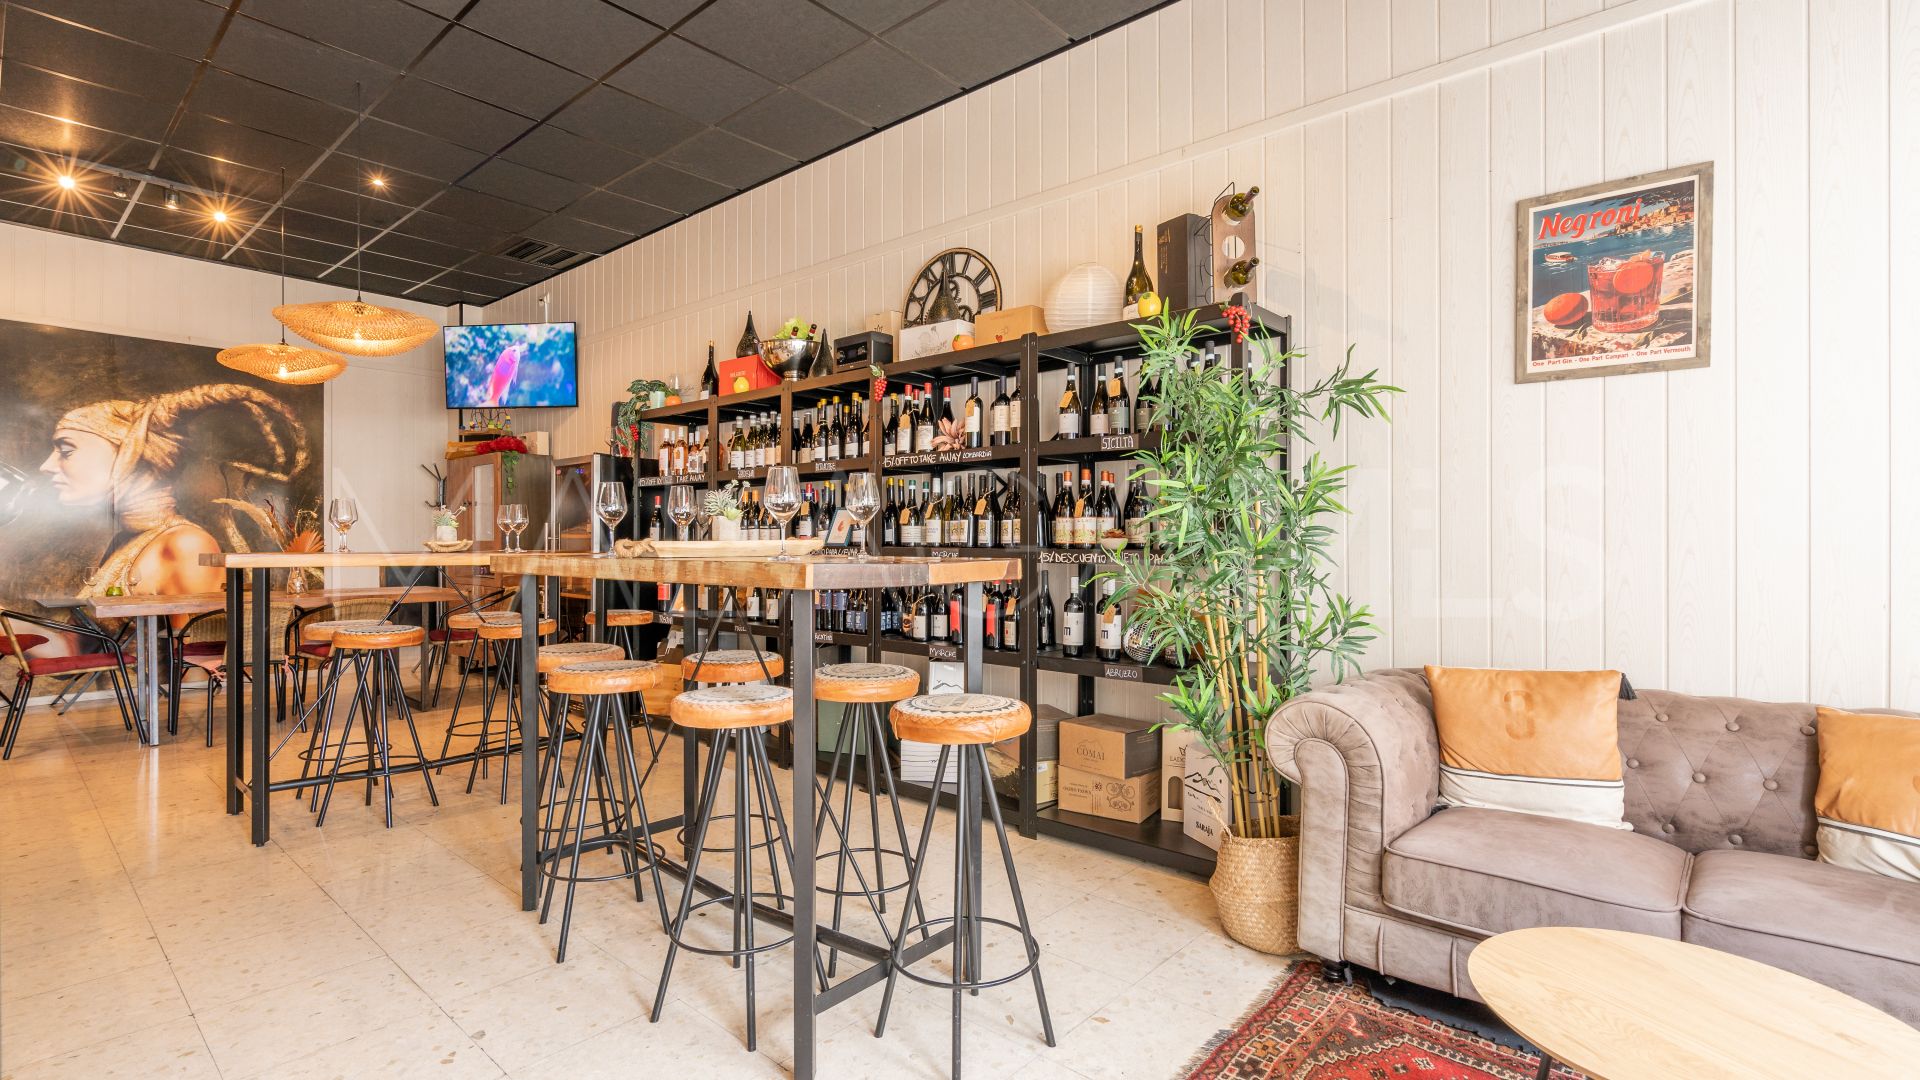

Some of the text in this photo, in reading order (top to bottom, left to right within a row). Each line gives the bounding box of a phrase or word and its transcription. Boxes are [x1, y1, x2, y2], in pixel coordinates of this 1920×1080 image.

[1537, 198, 1643, 240] Negroni
[1547, 358, 1561, 366] Part
[1592, 354, 1603, 362] Part
[1605, 353, 1629, 361] Campari
[1650, 348, 1662, 356] Part
[1664, 345, 1692, 354] Vermouth
[919, 454, 937, 464] TAKE
[940, 451, 962, 463] AWAY
